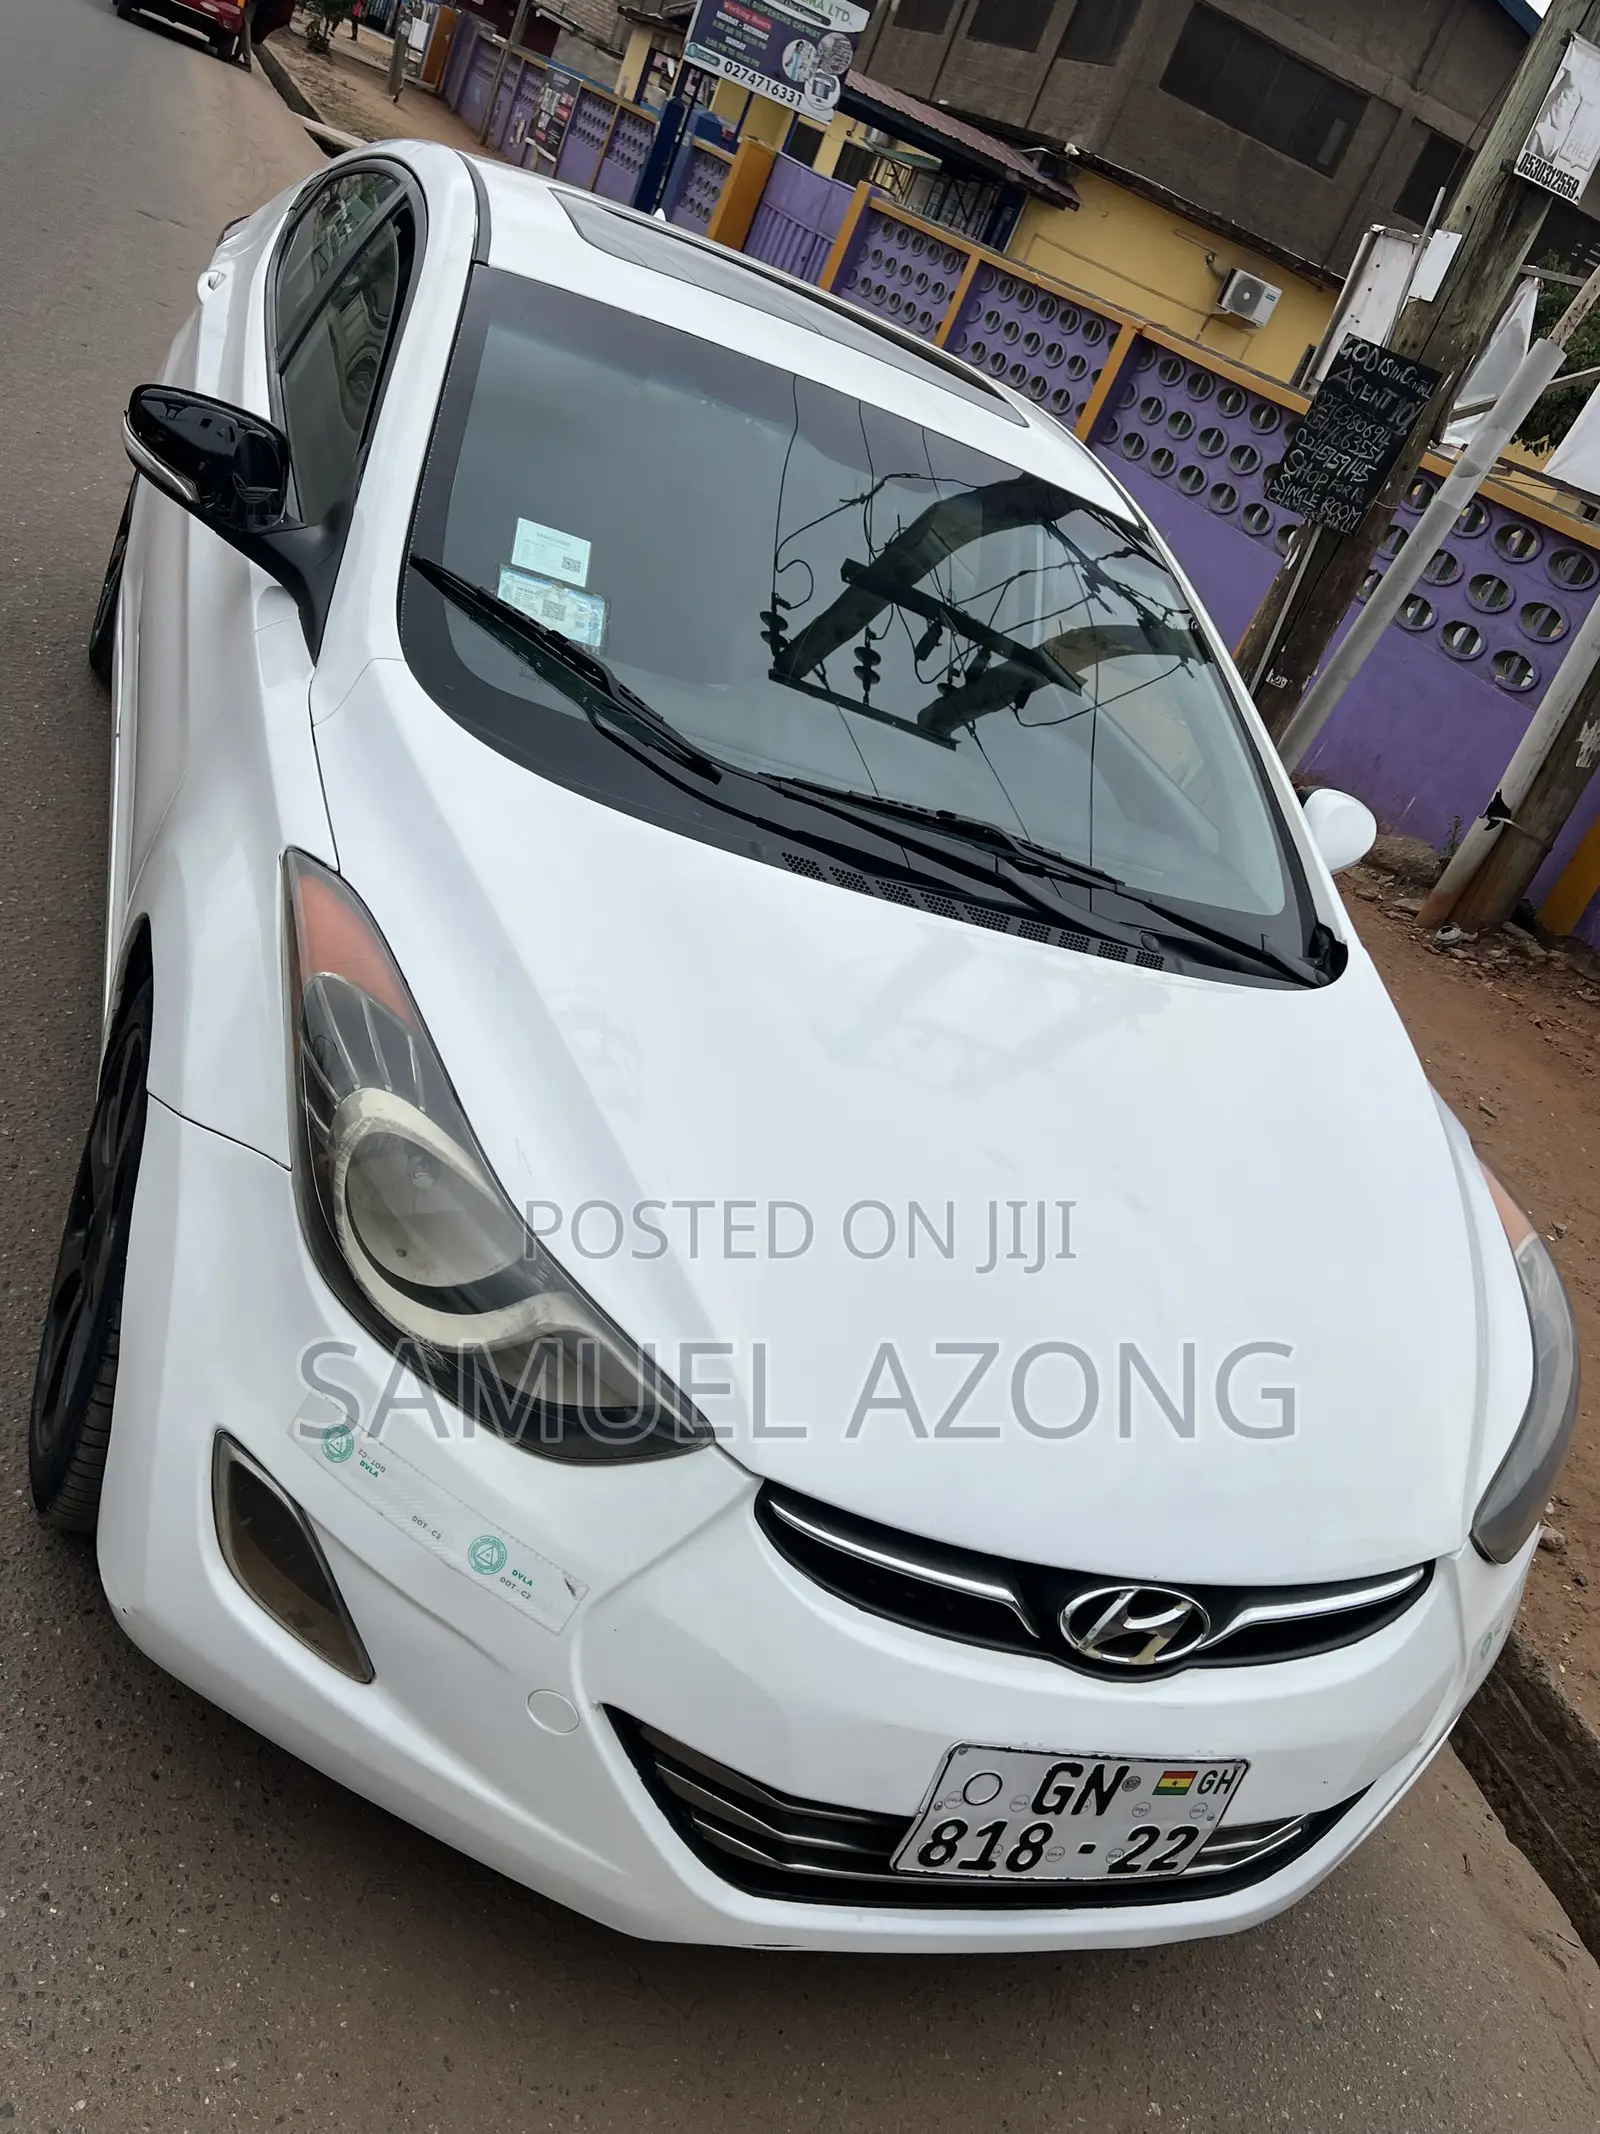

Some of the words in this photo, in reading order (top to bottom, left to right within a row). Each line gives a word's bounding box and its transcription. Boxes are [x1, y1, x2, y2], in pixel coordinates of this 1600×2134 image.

[724, 61, 802, 106] 0274716331
[1518, 152, 1580, 199] 0530312559
[1339, 337, 1379, 372] GOD
[1328, 366, 1398, 412] AGENT
[1274, 473, 1321, 508] SINGLE
[1320, 496, 1362, 529] ROOM
[359, 1460, 379, 1478] DVLA
[411, 1515, 428, 1529] DOT
[431, 1530, 442, 1540] C2
[499, 1576, 517, 1590] DOT
[520, 1590, 532, 1600] C2
[511, 1569, 533, 1587] DVLA
[1031, 1762, 1130, 1816] GN
[1196, 1769, 1238, 1795] GH
[917, 1818, 1054, 1873] 818
[1106, 1824, 1200, 1875] 22
